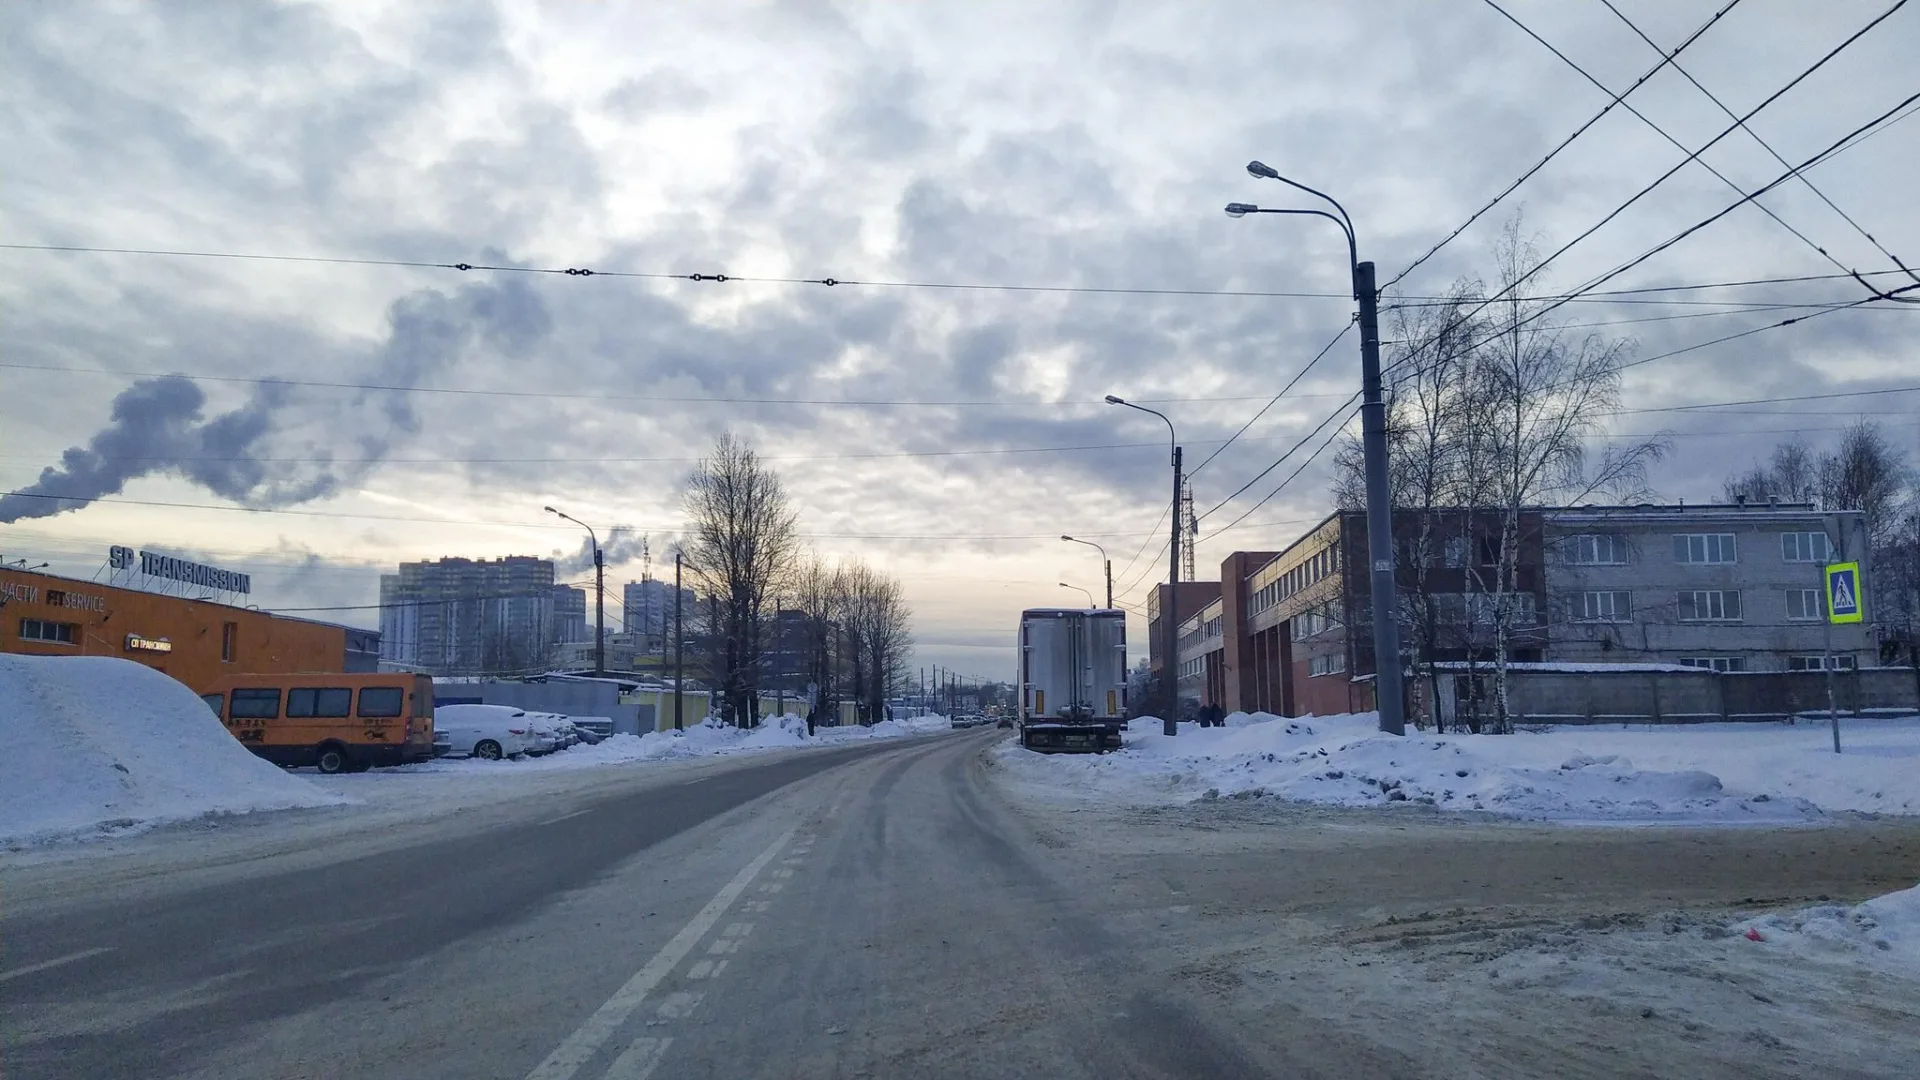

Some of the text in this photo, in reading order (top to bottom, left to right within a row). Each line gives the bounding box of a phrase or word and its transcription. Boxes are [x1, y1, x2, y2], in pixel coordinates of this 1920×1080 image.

[110, 545, 250, 594] SP TRANSMISSION
[65, 591, 105, 613] SERVICE
